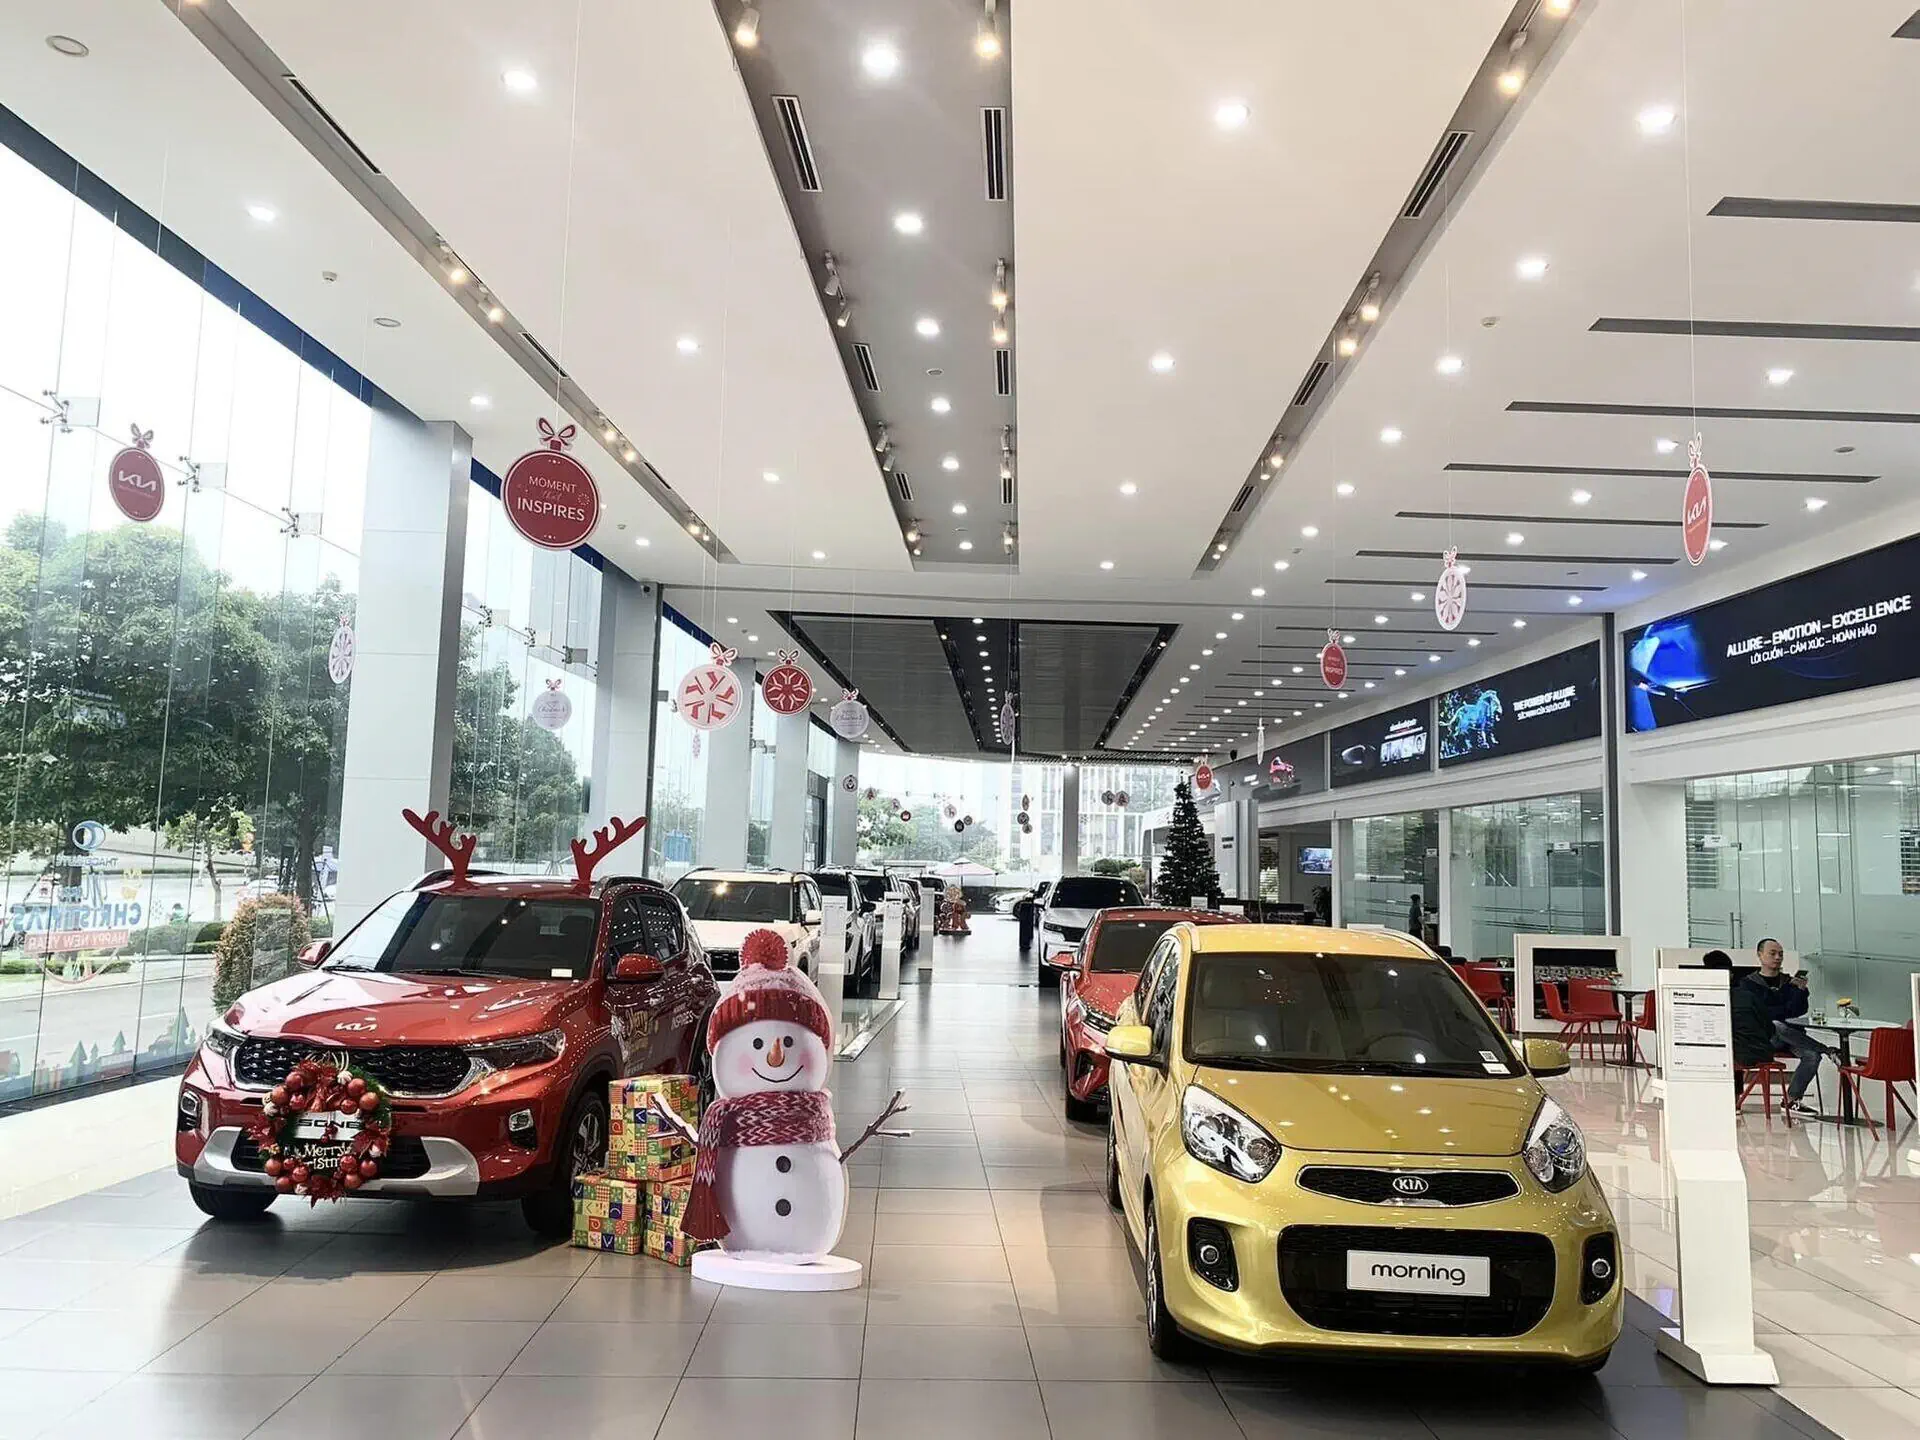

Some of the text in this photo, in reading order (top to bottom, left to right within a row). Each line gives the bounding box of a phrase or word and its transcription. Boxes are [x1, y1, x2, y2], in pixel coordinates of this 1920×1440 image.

[529, 476, 577, 493] MOMENT
[517, 497, 585, 521] INSPIRES
[1727, 636, 1764, 657] ALLURE
[1772, 620, 1822, 645] EMOTION
[1832, 595, 1911, 630] EXCELLENCE
[1399, 1179, 1424, 1191] KIA
[1371, 1264, 1466, 1286] morning
